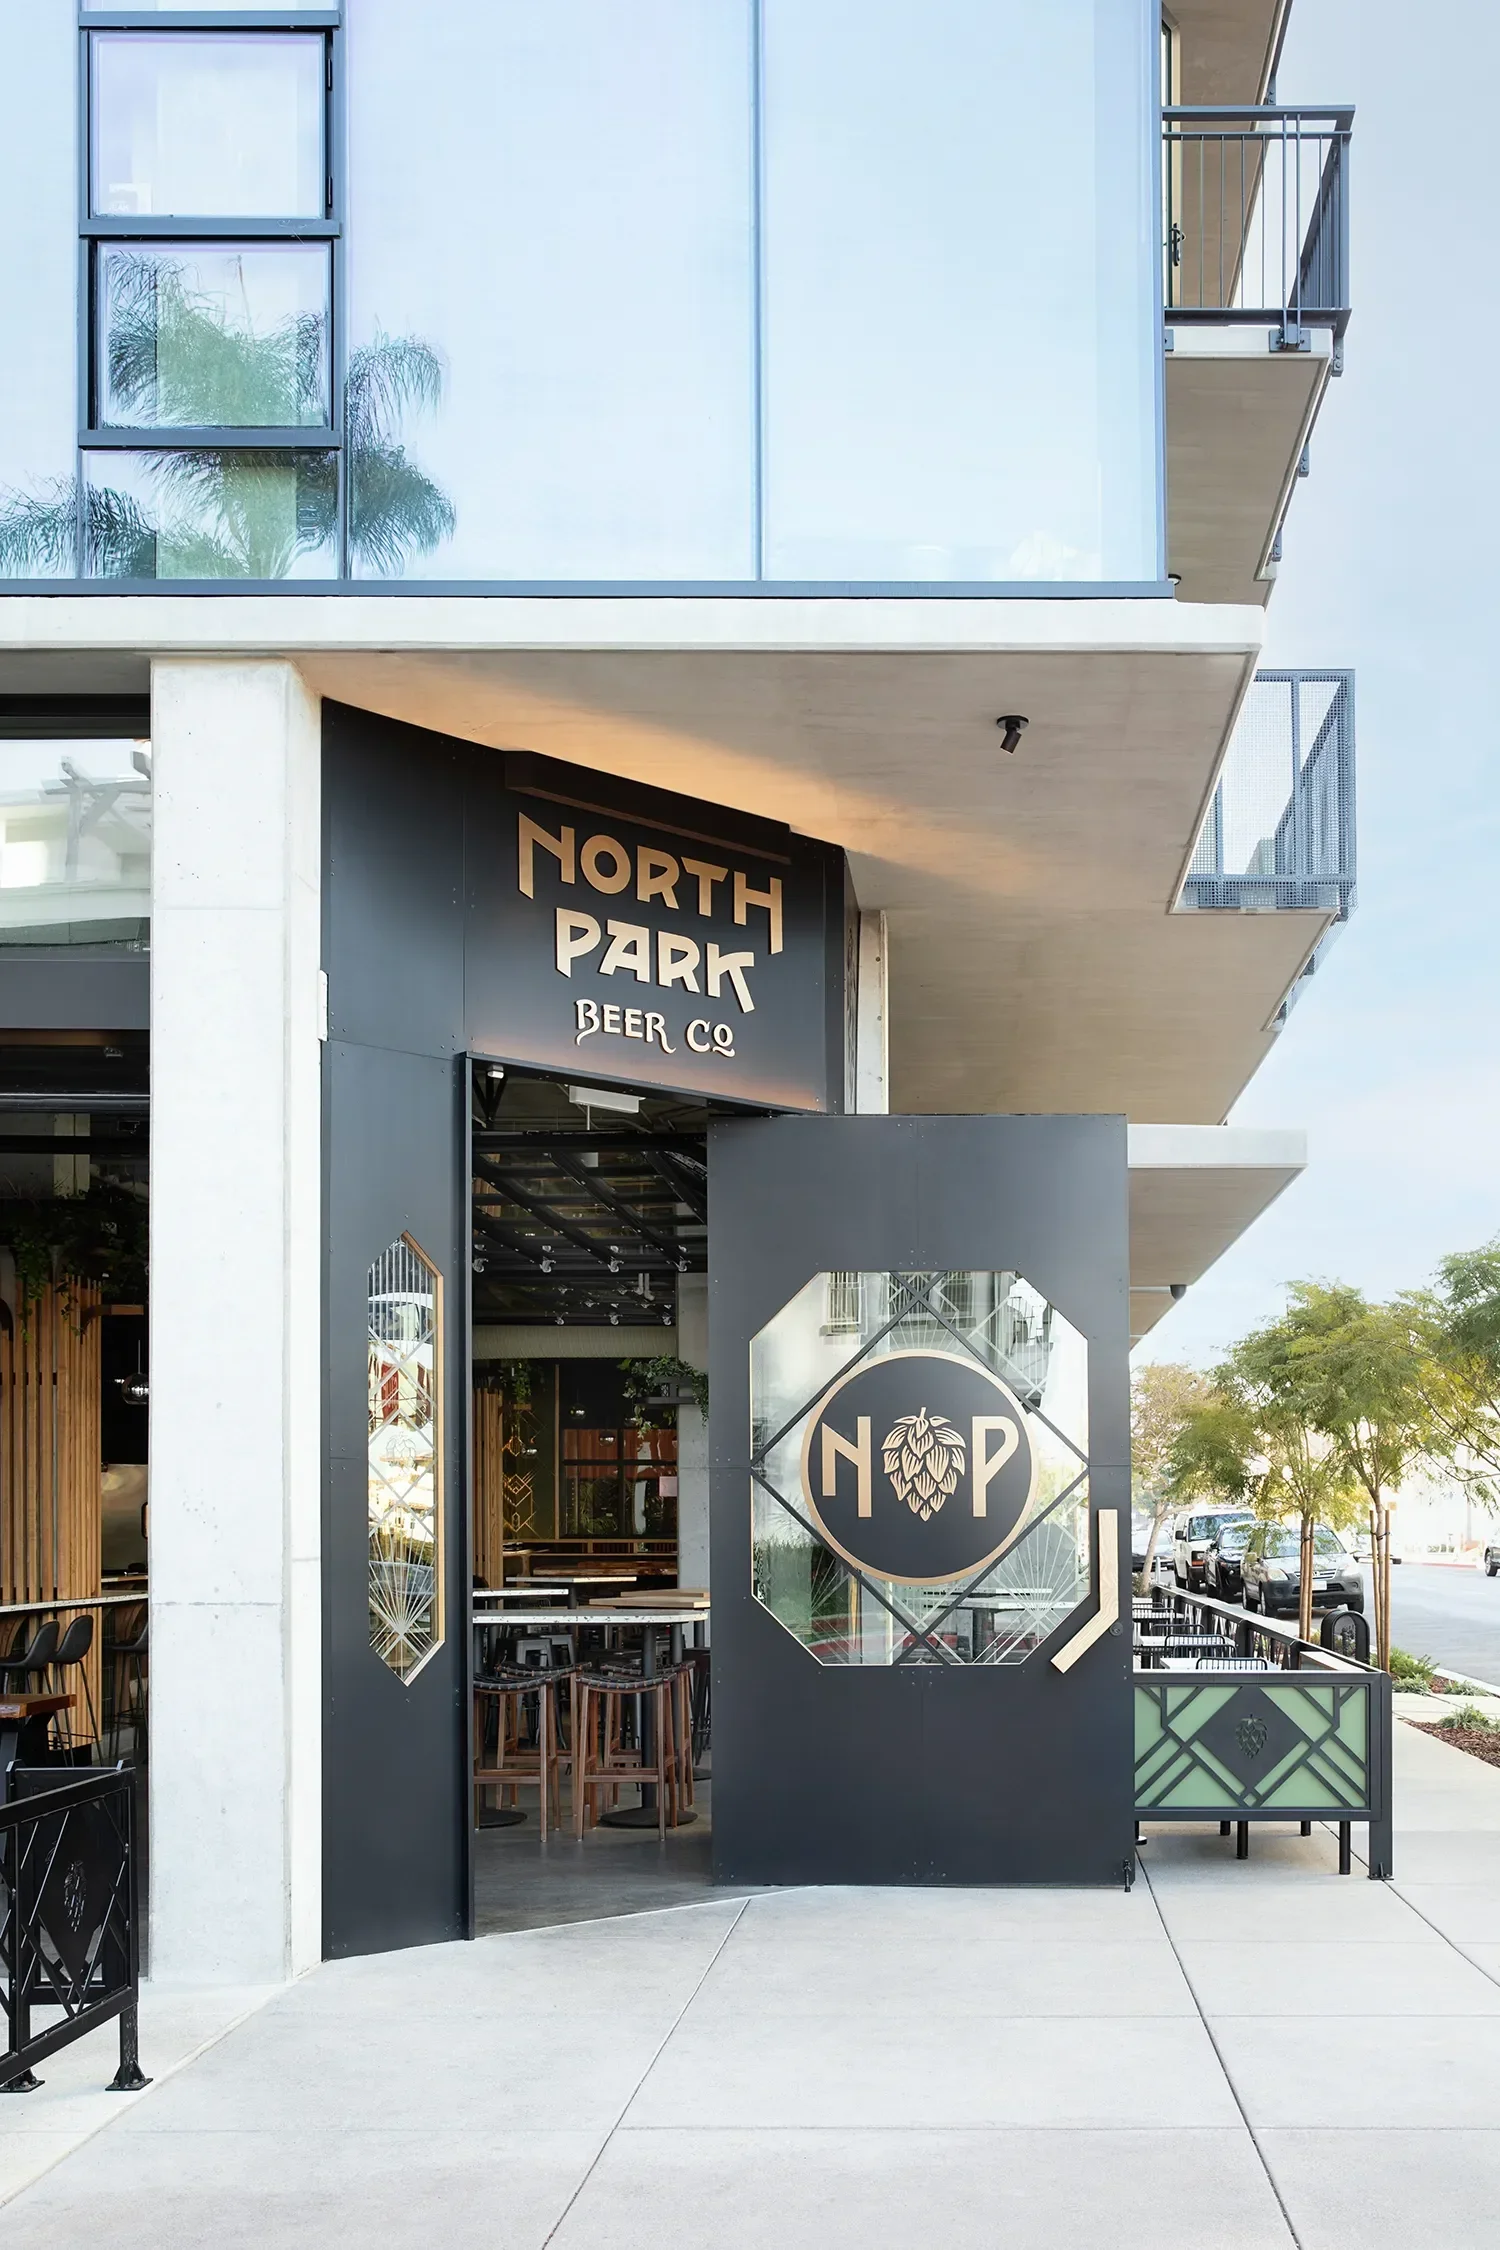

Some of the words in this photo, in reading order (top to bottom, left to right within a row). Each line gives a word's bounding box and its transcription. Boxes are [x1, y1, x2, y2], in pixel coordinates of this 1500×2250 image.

[518, 811, 784, 956] NORTH
[556, 907, 756, 1014] PARK
[575, 998, 677, 1055] BEER
